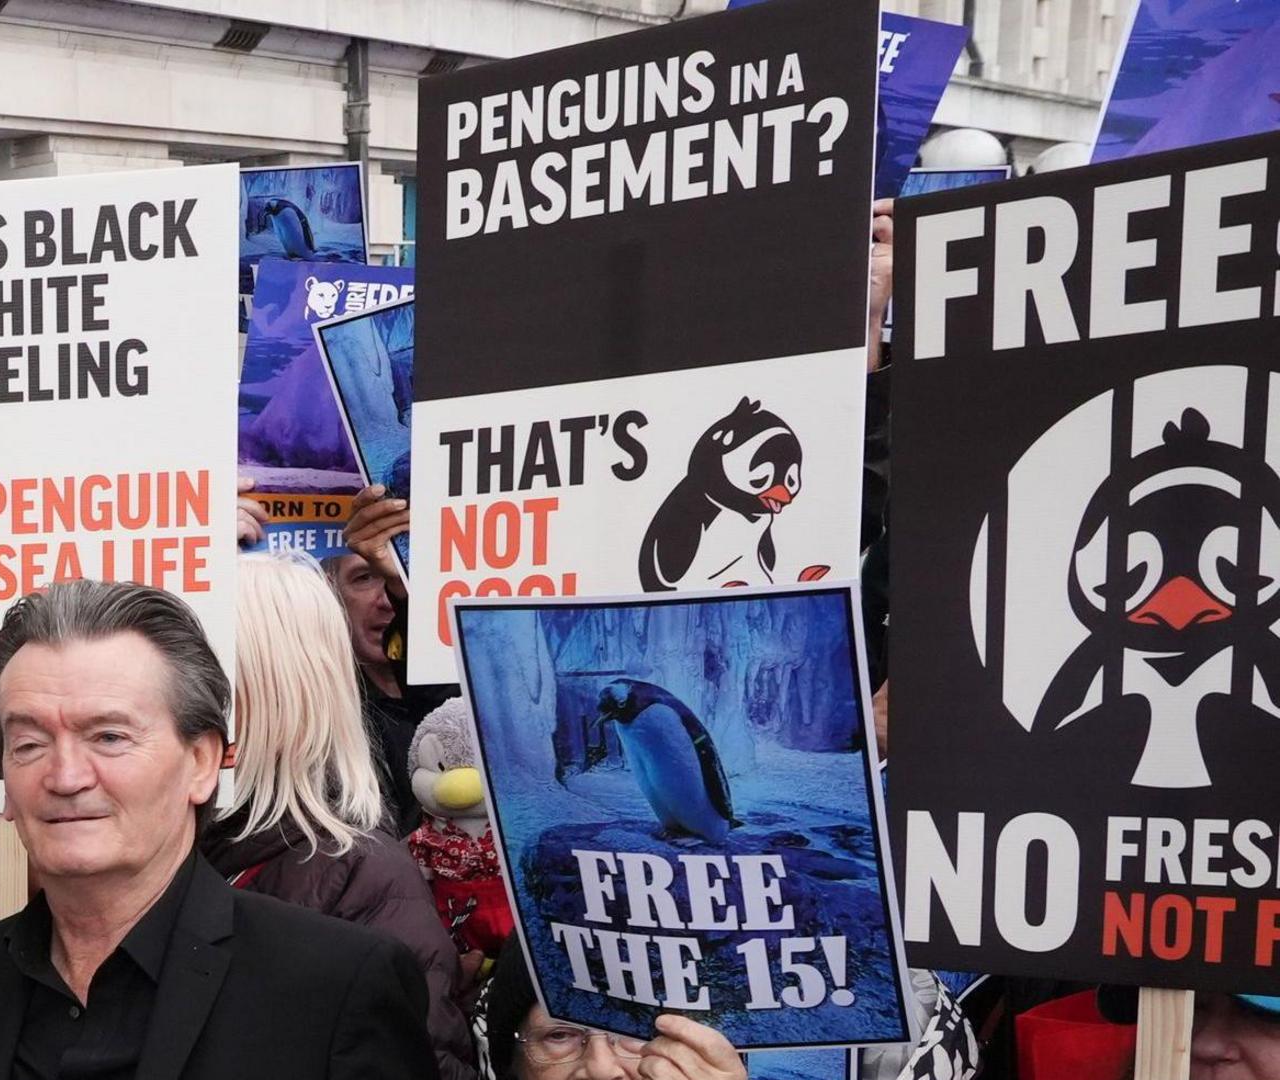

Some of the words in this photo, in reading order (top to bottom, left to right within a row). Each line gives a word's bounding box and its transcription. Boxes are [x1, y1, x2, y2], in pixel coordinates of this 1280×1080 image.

[446, 50, 716, 161] PENGUINS
[730, 60, 768, 106] IN
[777, 53, 805, 96] A
[446, 97, 849, 241] BASEMENT?
[23, 198, 199, 268] BLACK
[914, 157, 1268, 359] FREE
[440, 410, 649, 497] THAT'S
[268, 529, 317, 555] FREE
[313, 502, 340, 518] TO
[440, 497, 559, 572] NOT
[571, 848, 796, 932] FREE
[904, 810, 1080, 952] NO
[1105, 815, 1280, 889] FRES
[550, 922, 710, 1012] THE
[735, 935, 856, 1010] 15!
[1102, 891, 1237, 963] NOT
